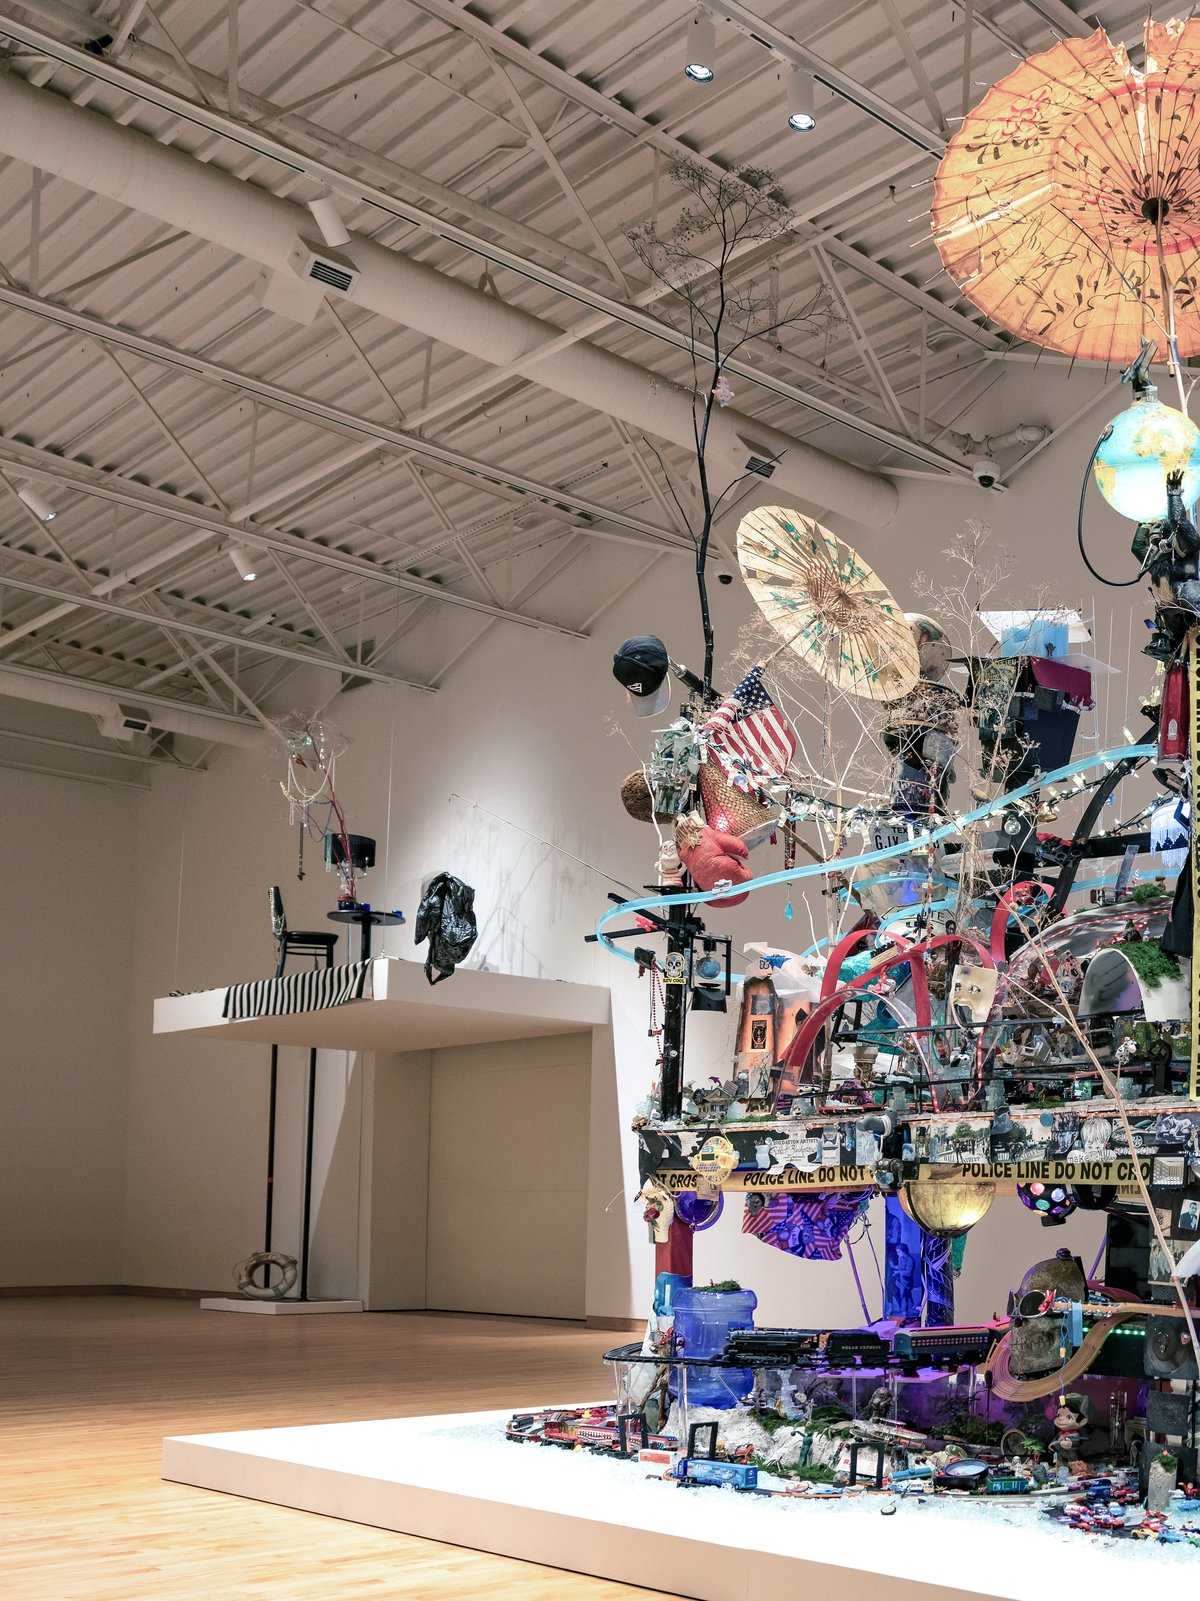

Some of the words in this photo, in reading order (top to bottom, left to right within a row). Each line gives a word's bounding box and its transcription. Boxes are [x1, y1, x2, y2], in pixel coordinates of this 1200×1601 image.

[892, 827, 920, 835] TEXS
[743, 1171, 787, 1187] POLICE
[788, 1169, 815, 1185] LINE
[818, 1167, 837, 1182] DO
[840, 1165, 866, 1182] NOT
[962, 1162, 1012, 1179] POLICE
[1017, 1161, 1050, 1179] LINE
[1055, 1162, 1075, 1180] DO
[1080, 1162, 1112, 1180] NOT
[669, 1173, 698, 1188] CROS
